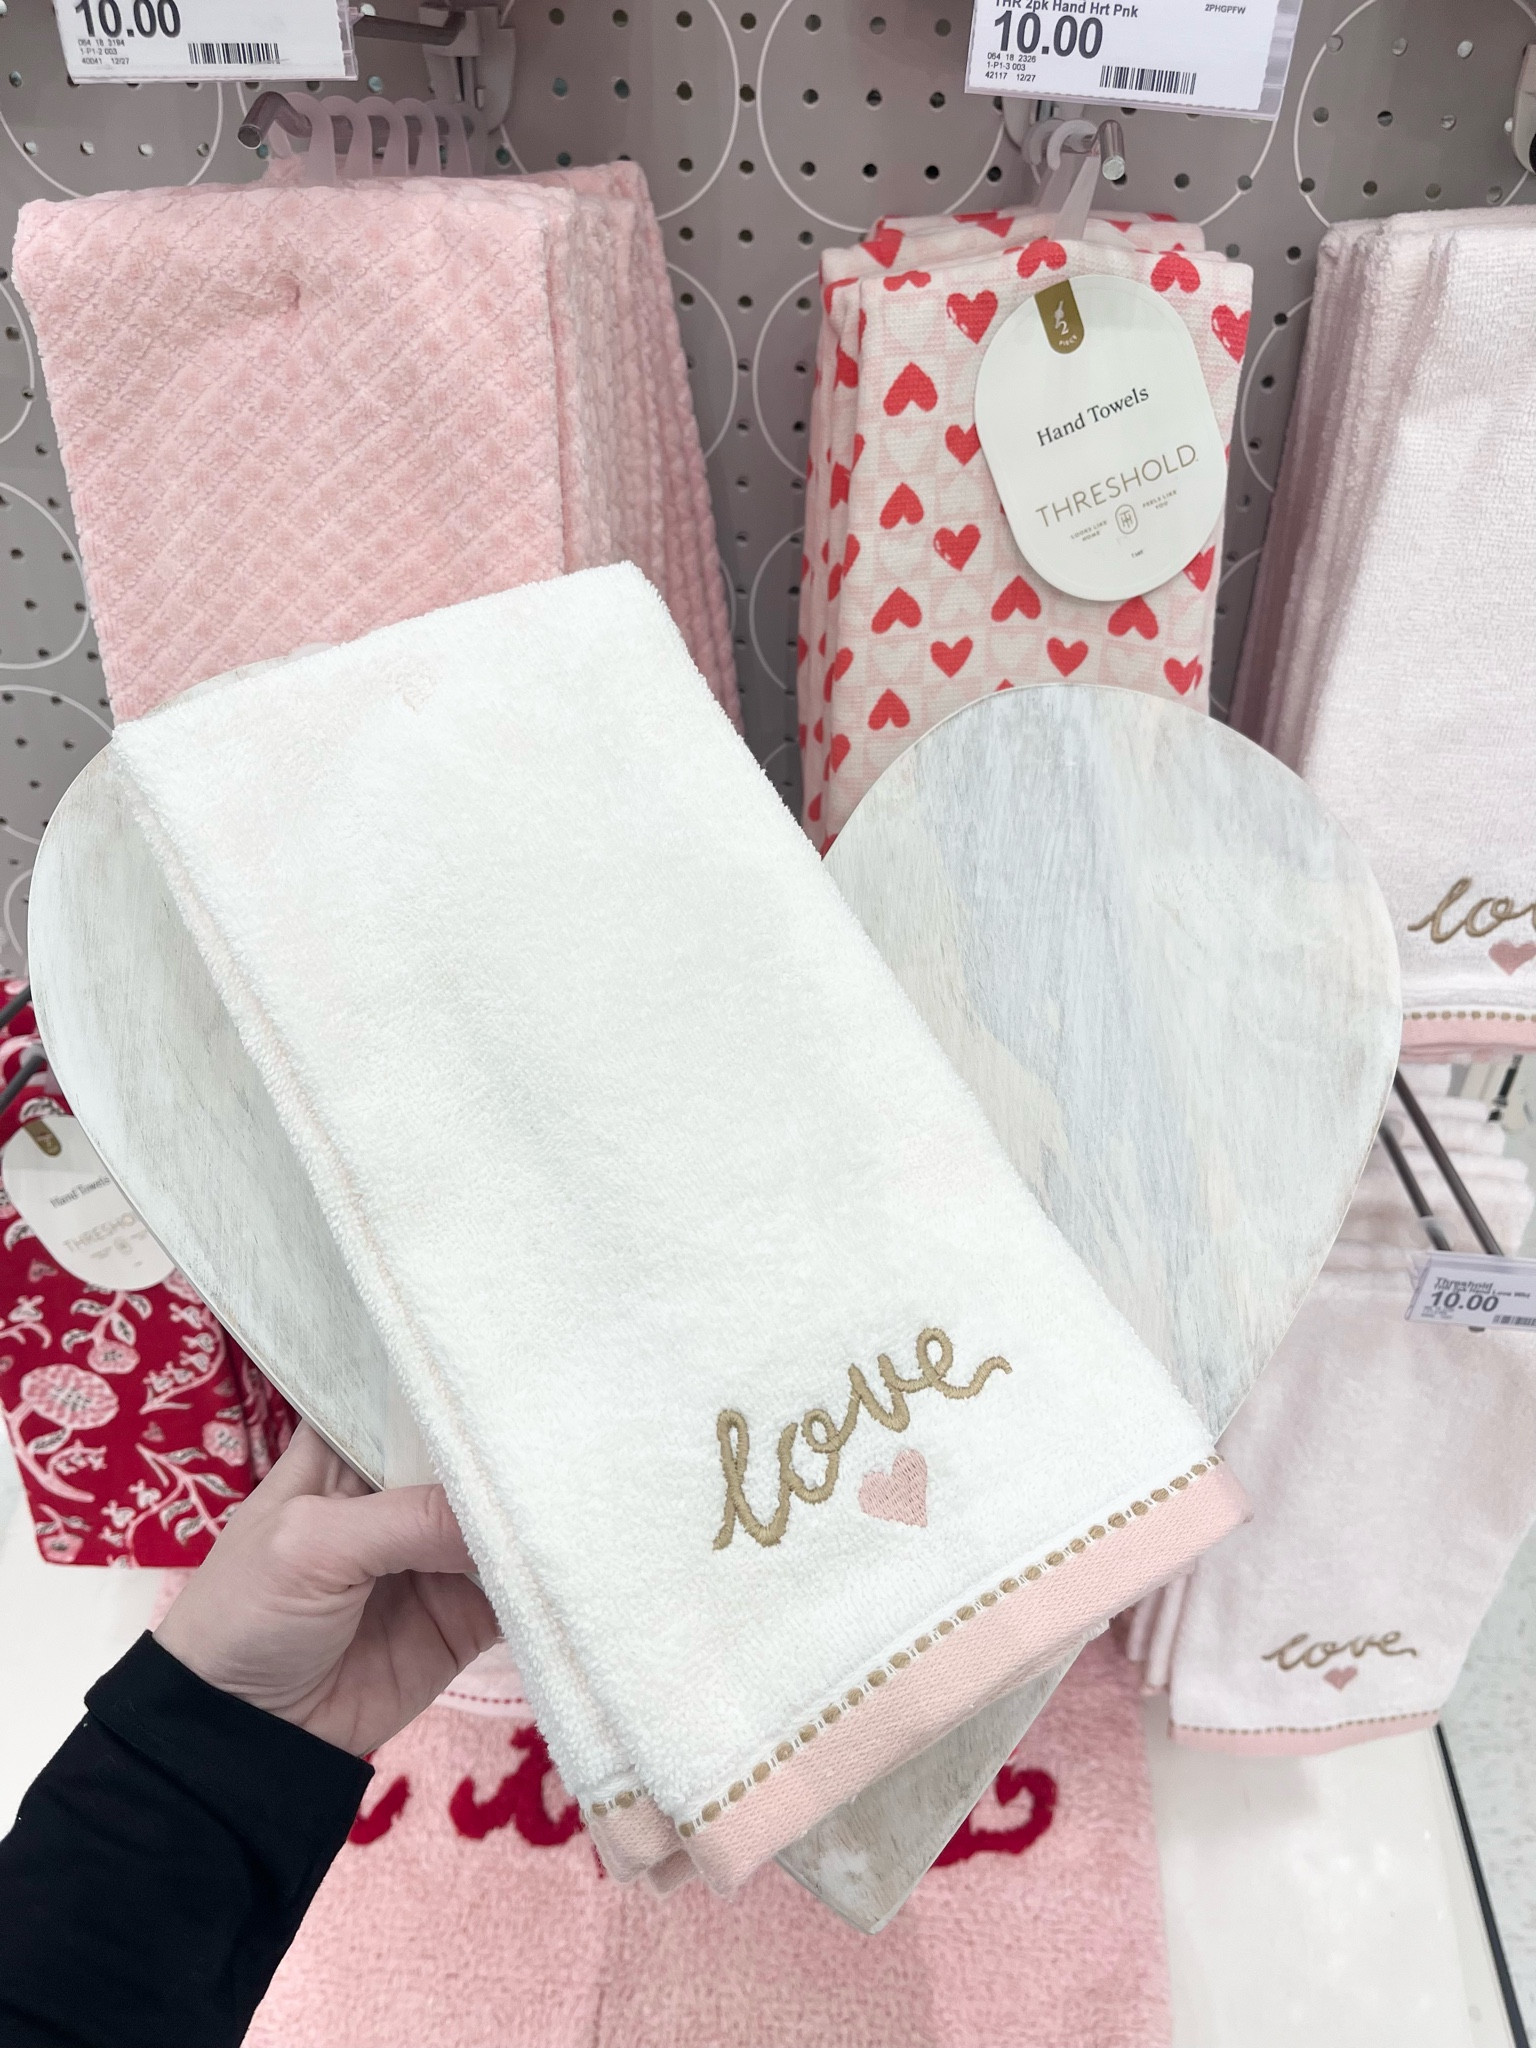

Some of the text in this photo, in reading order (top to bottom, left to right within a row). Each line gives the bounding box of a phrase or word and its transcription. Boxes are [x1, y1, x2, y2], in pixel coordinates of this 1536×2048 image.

[75, 0, 181, 38] 10.00
[1025, 0, 1049, 12] 2pk
[1052, 0, 1086, 14] Hand
[1090, 1, 1110, 16] Hrt
[1113, 4, 1138, 18] Pnk
[994, 10, 1103, 59] 10.00
[985, 71, 1036, 82] 42117 12/27
[986, 62, 1026, 72] 1-P1-3 003
[987, 52, 1037, 63] 064 18 2326
[1060, 320, 1070, 336] 2
[1036, 387, 1150, 447] Hand Towels
[1035, 444, 1197, 528] THRESHOLD
[62, 1212, 136, 1252] THRESHO
[1431, 1291, 1499, 1313] 10.00
[712, 1327, 1013, 1550] love
[1261, 1630, 1418, 1671] love
